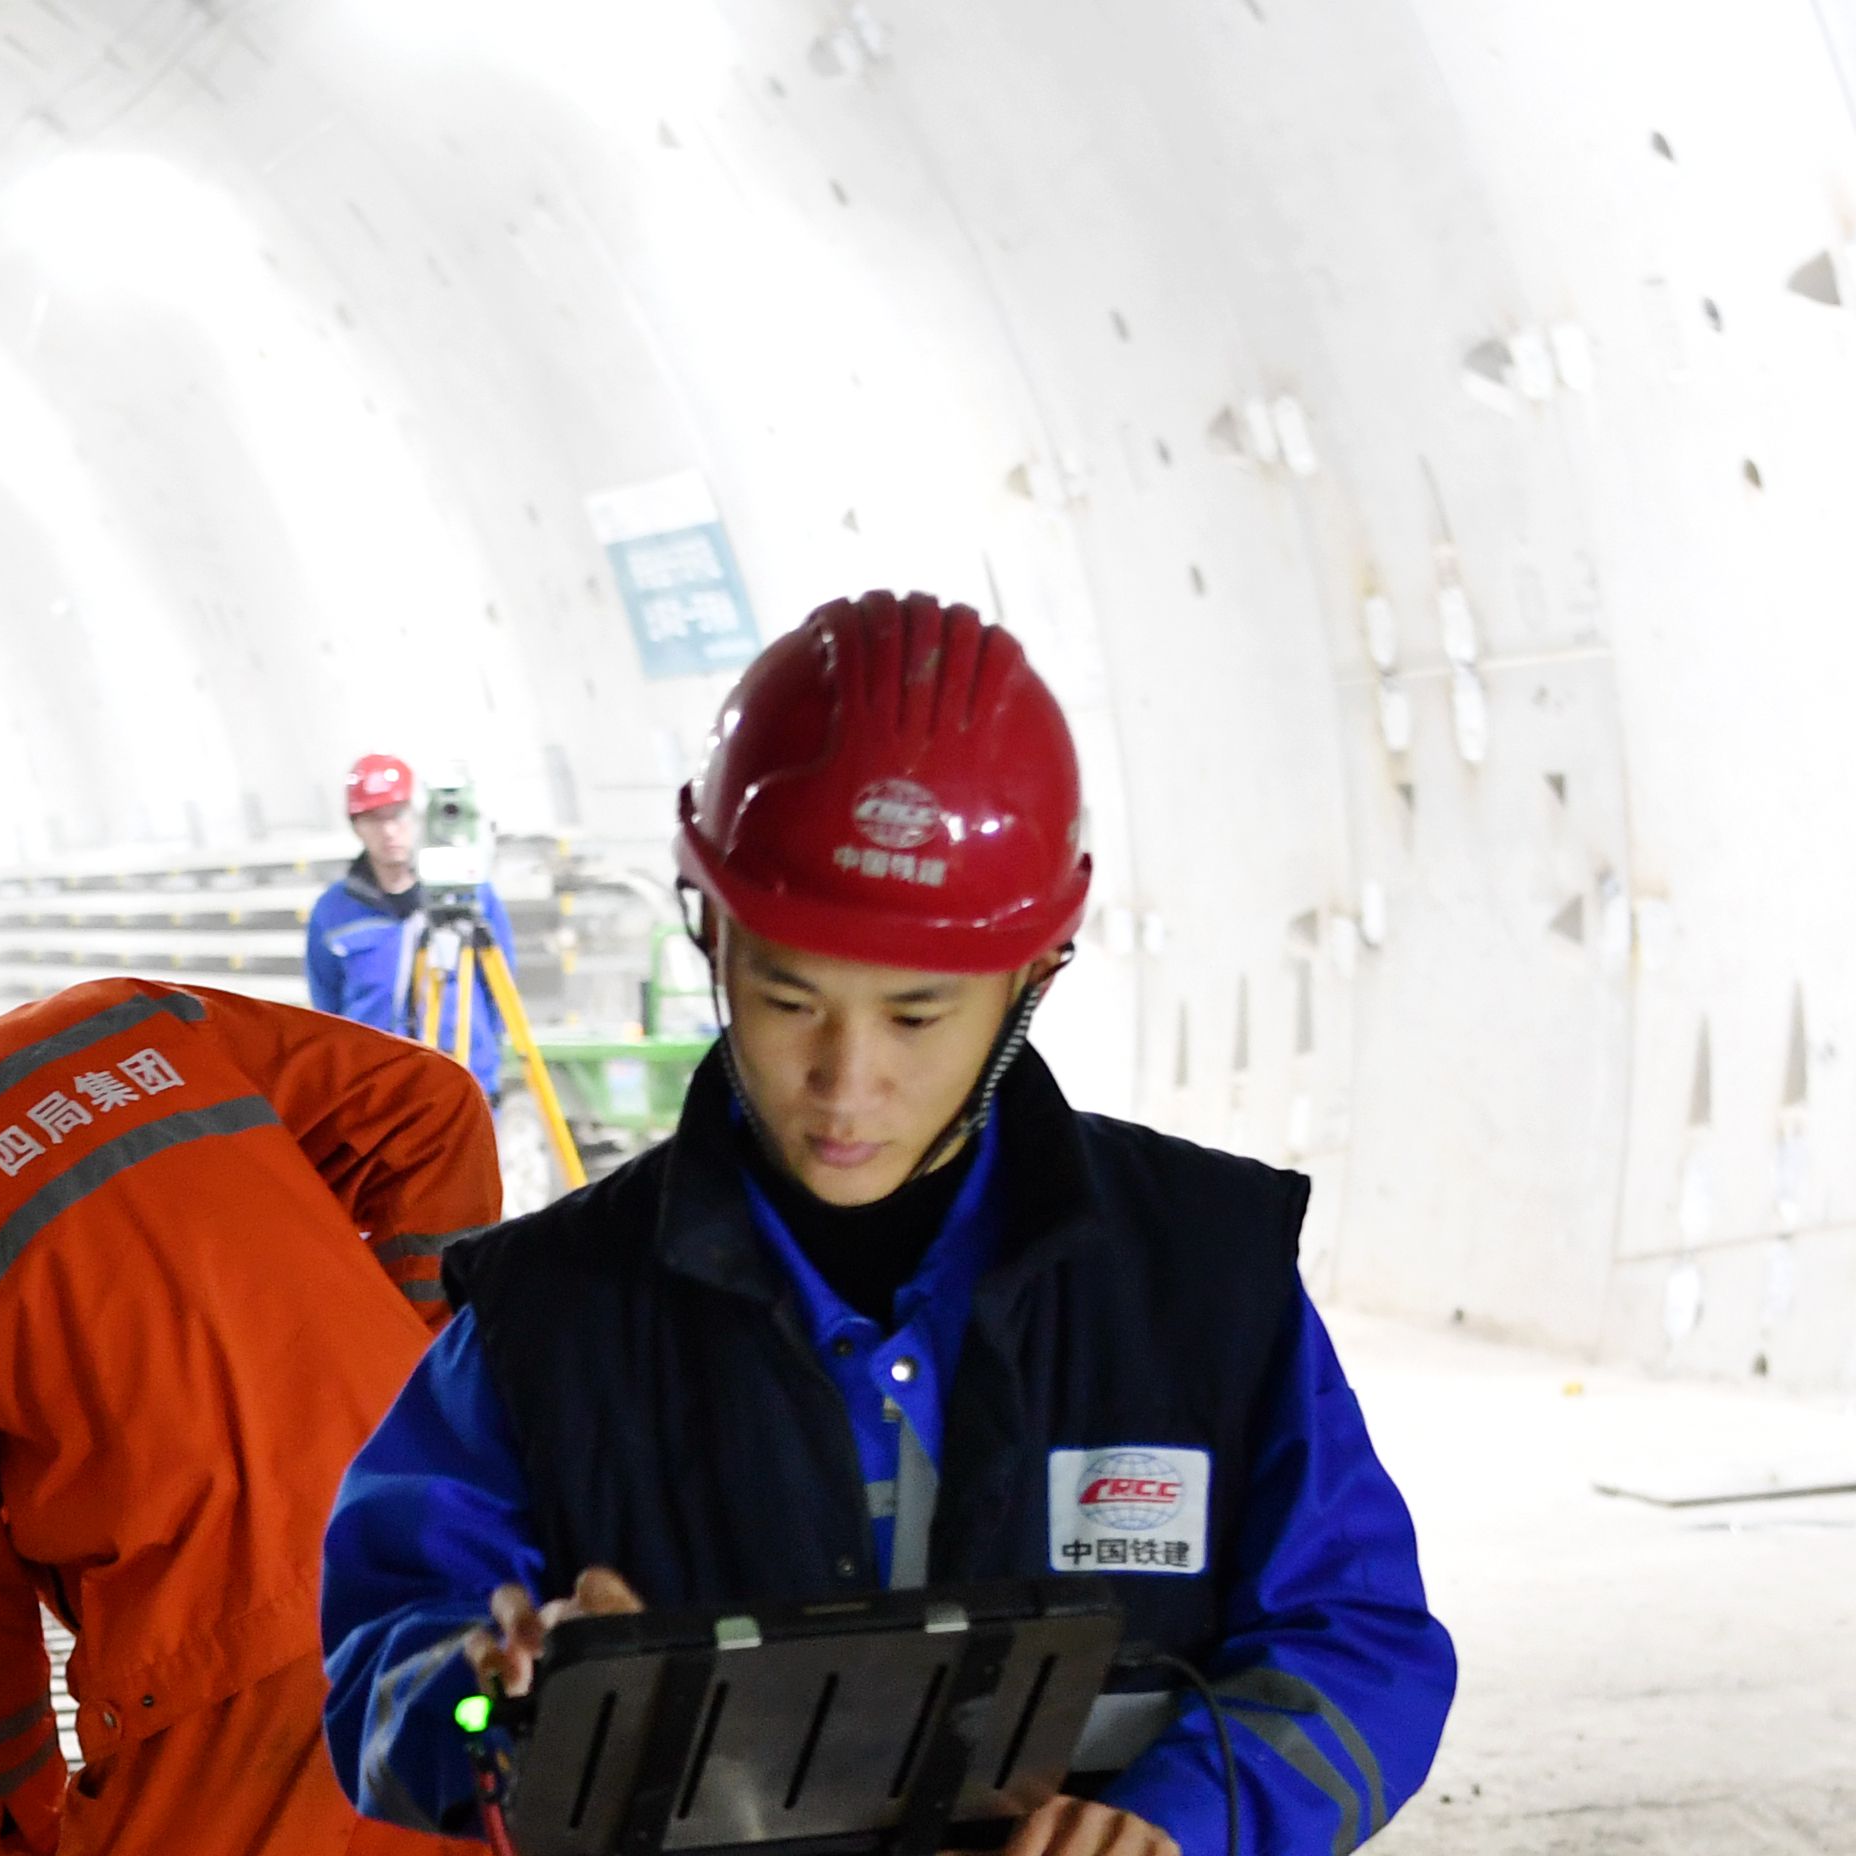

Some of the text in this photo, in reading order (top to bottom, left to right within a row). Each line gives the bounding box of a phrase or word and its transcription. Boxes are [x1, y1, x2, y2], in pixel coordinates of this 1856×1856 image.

[1078, 1477, 1184, 1505] CRCC
[1061, 1537, 1192, 1568] 中国铁建
